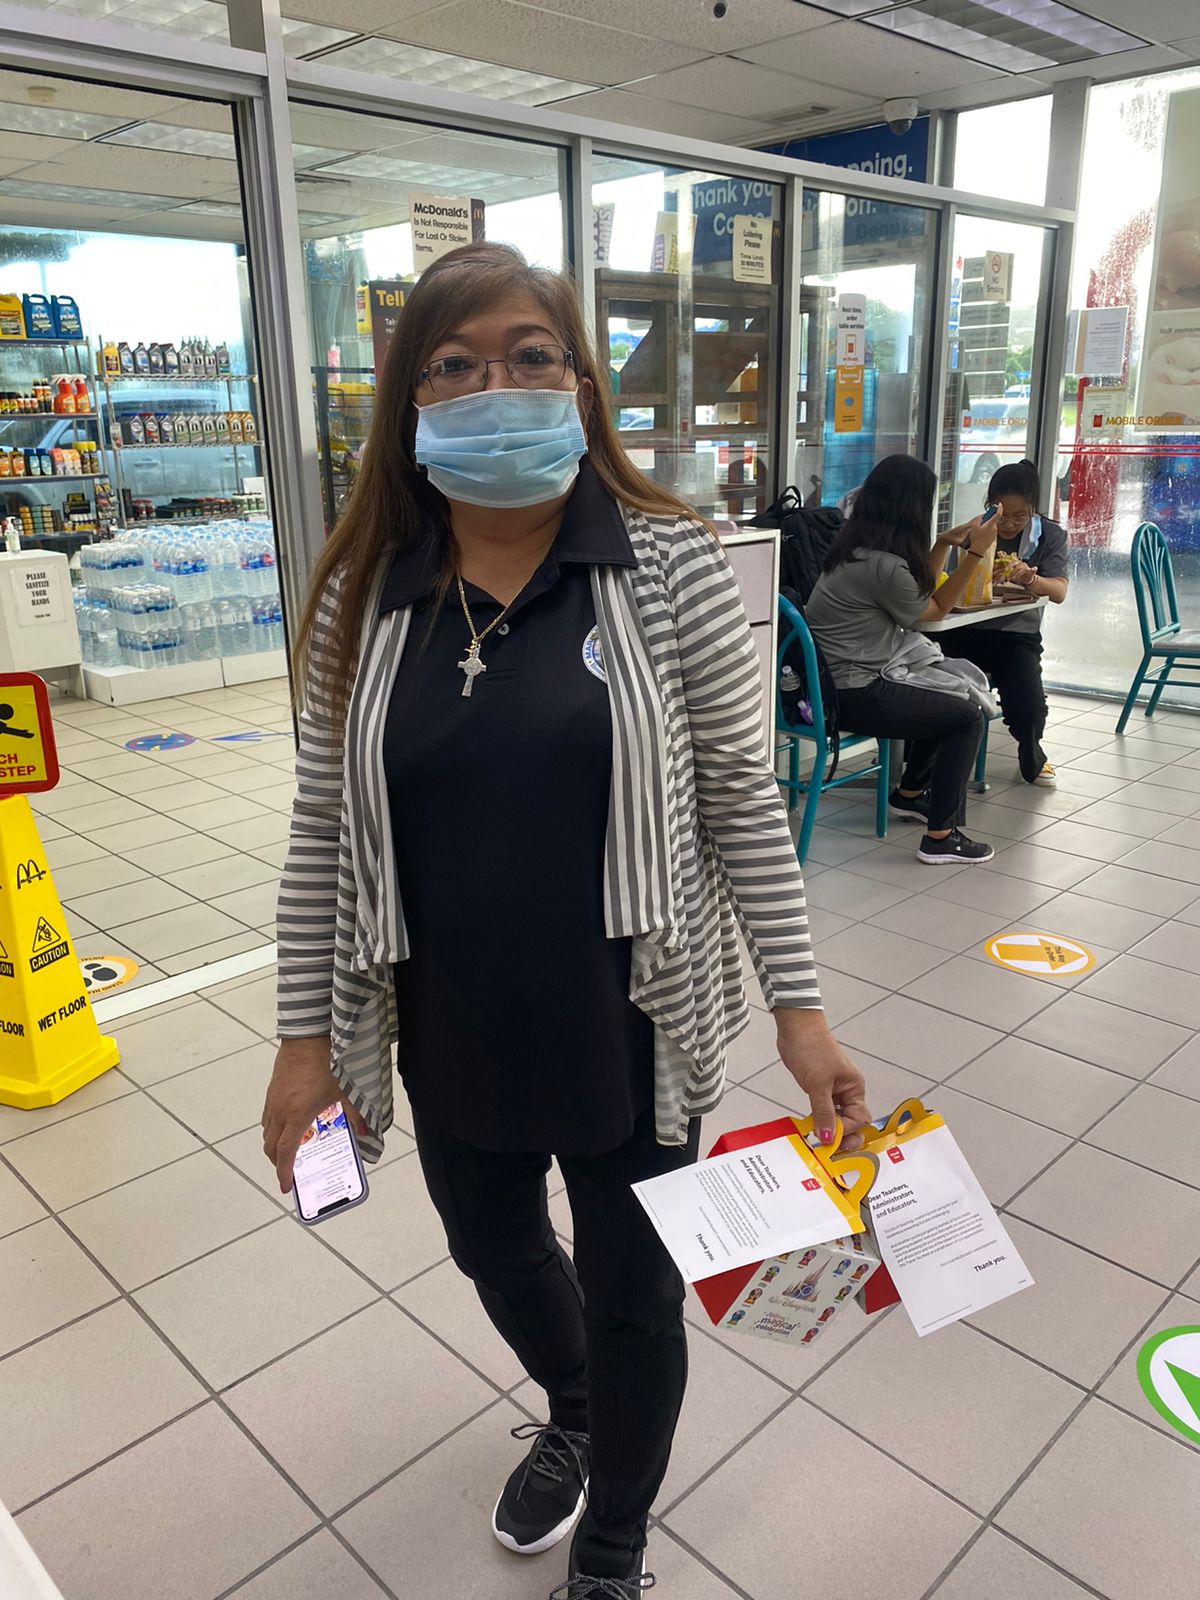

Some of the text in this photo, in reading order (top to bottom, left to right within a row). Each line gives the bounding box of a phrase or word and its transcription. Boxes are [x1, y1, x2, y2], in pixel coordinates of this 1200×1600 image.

[414, 203, 469, 218] McDonald's
[414, 217, 469, 231] Is Not Responsible
[415, 231, 468, 243] For Lost Or Stolen
[744, 240, 761, 248] Please
[376, 289, 405, 307] Tell
[974, 418, 1028, 426] MOBILE ORD
[1106, 416, 1144, 425] MOBILE
[1145, 416, 1183, 425] ORDER
[26, 572, 46, 580] PLEASE
[25, 580, 49, 589] SANITIZE
[31, 589, 47, 597] YOUR
[31, 598, 50, 606] HANDS
[0, 765, 37, 777] STEP
[32, 944, 68, 970] CAUTION
[38, 996, 87, 1031] WET FLOOR
[740, 1158, 765, 1194] and Educators,
[748, 1157, 774, 1193] Administrators
[756, 1154, 781, 1190] Dear Teachers,
[868, 1183, 909, 1203] Dear Teachers,
[872, 1189, 914, 1211] Administrators
[876, 1198, 918, 1219] and Educators,
[695, 1233, 715, 1262] Thank you.
[974, 1255, 1008, 1273] Thank you.
[760, 1317, 797, 1331] magical
